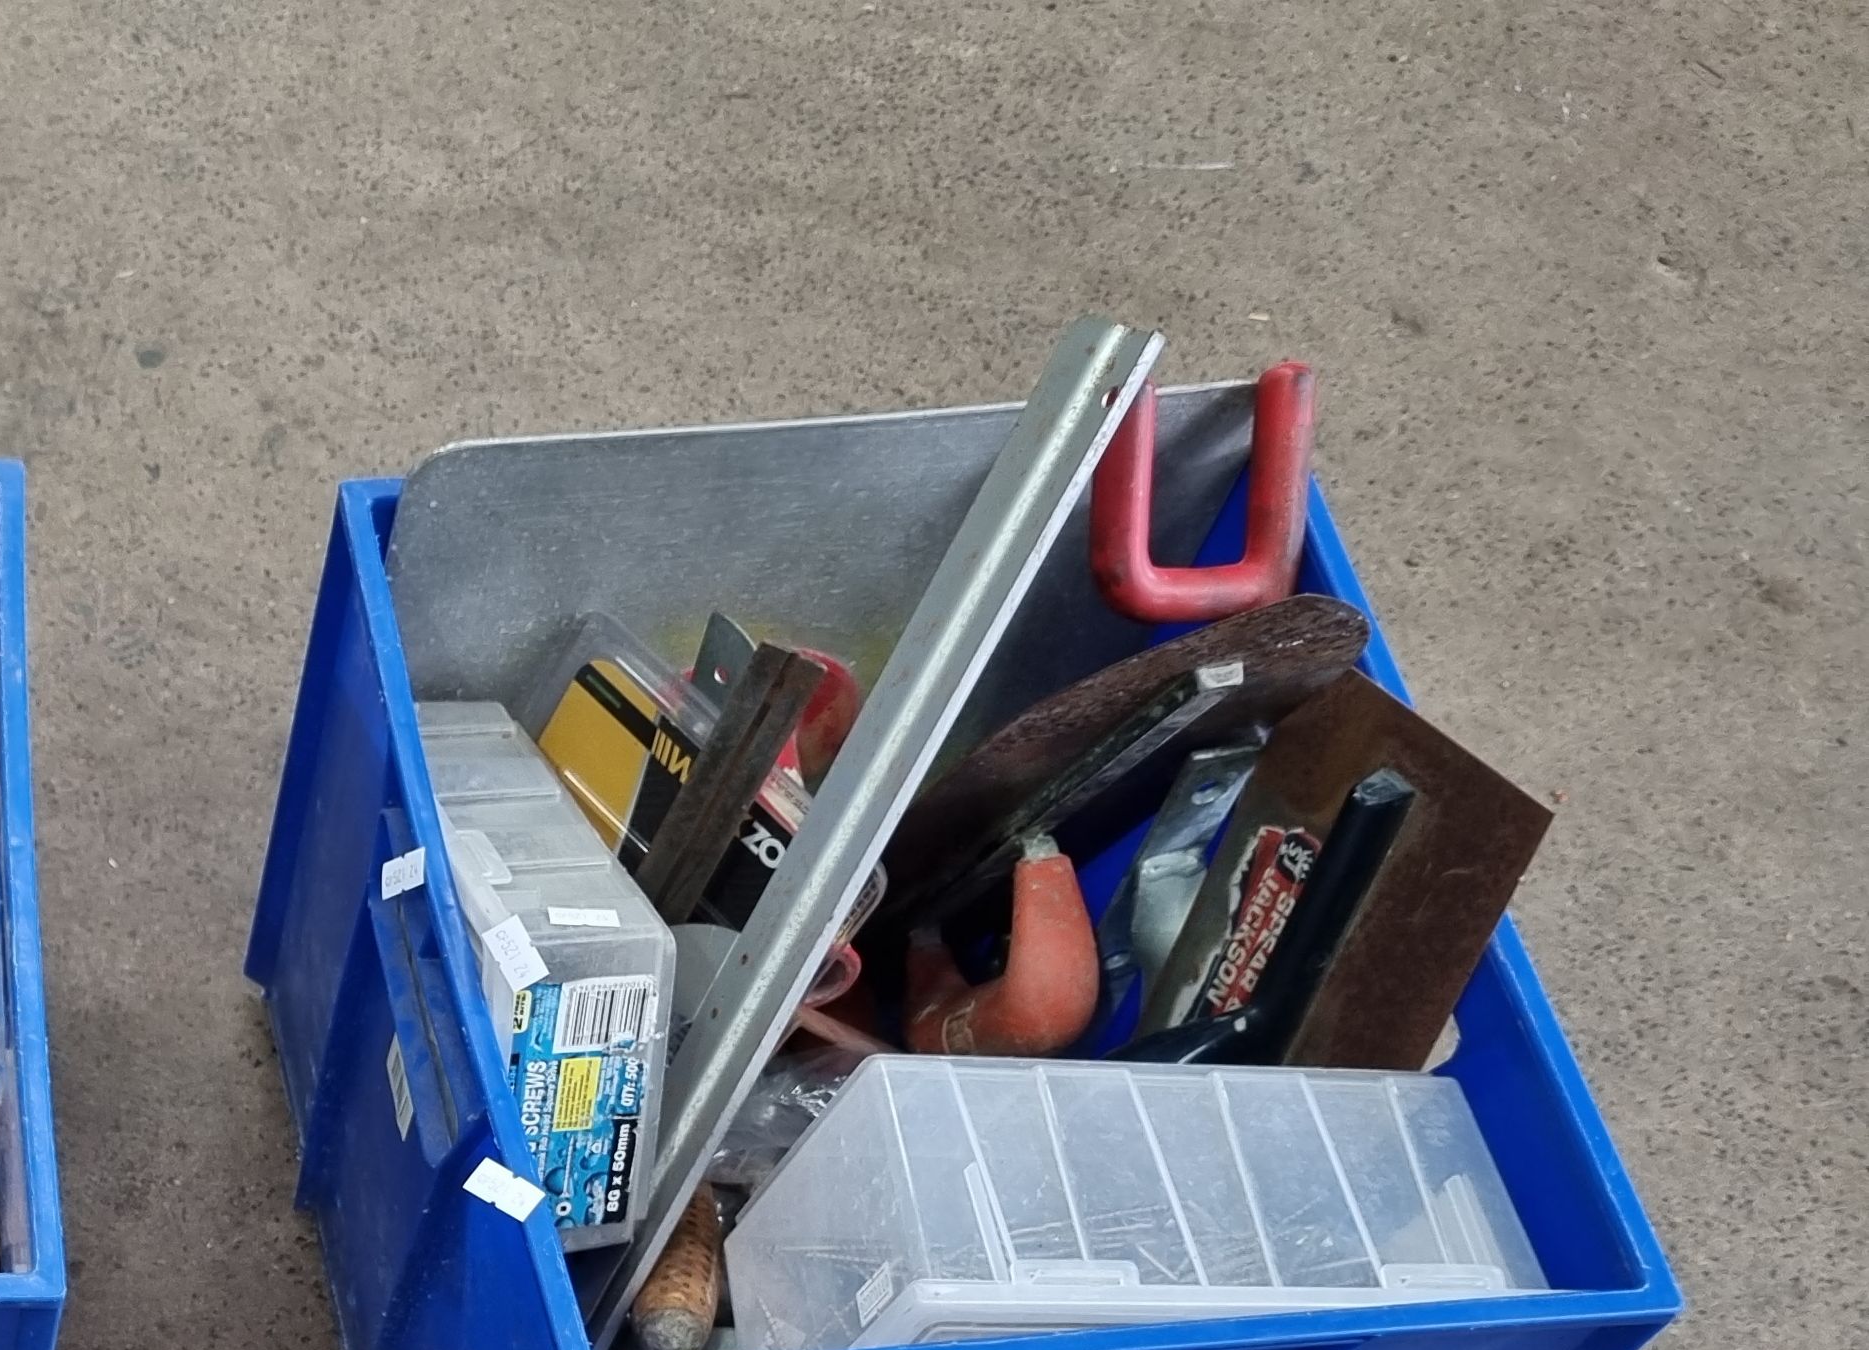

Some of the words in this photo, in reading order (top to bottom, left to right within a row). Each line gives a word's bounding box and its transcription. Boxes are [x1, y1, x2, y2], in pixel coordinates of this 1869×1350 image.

[1207, 869, 1280, 1006] JACKSON
[1239, 891, 1295, 992] SPEAR
[513, 1017, 523, 1031] 2
[521, 1060, 547, 1135] SCREWS
[544, 1084, 556, 1112] Square
[621, 1083, 635, 1107] QTY:
[611, 1123, 630, 1172] 50mm
[611, 1175, 622, 1186] x
